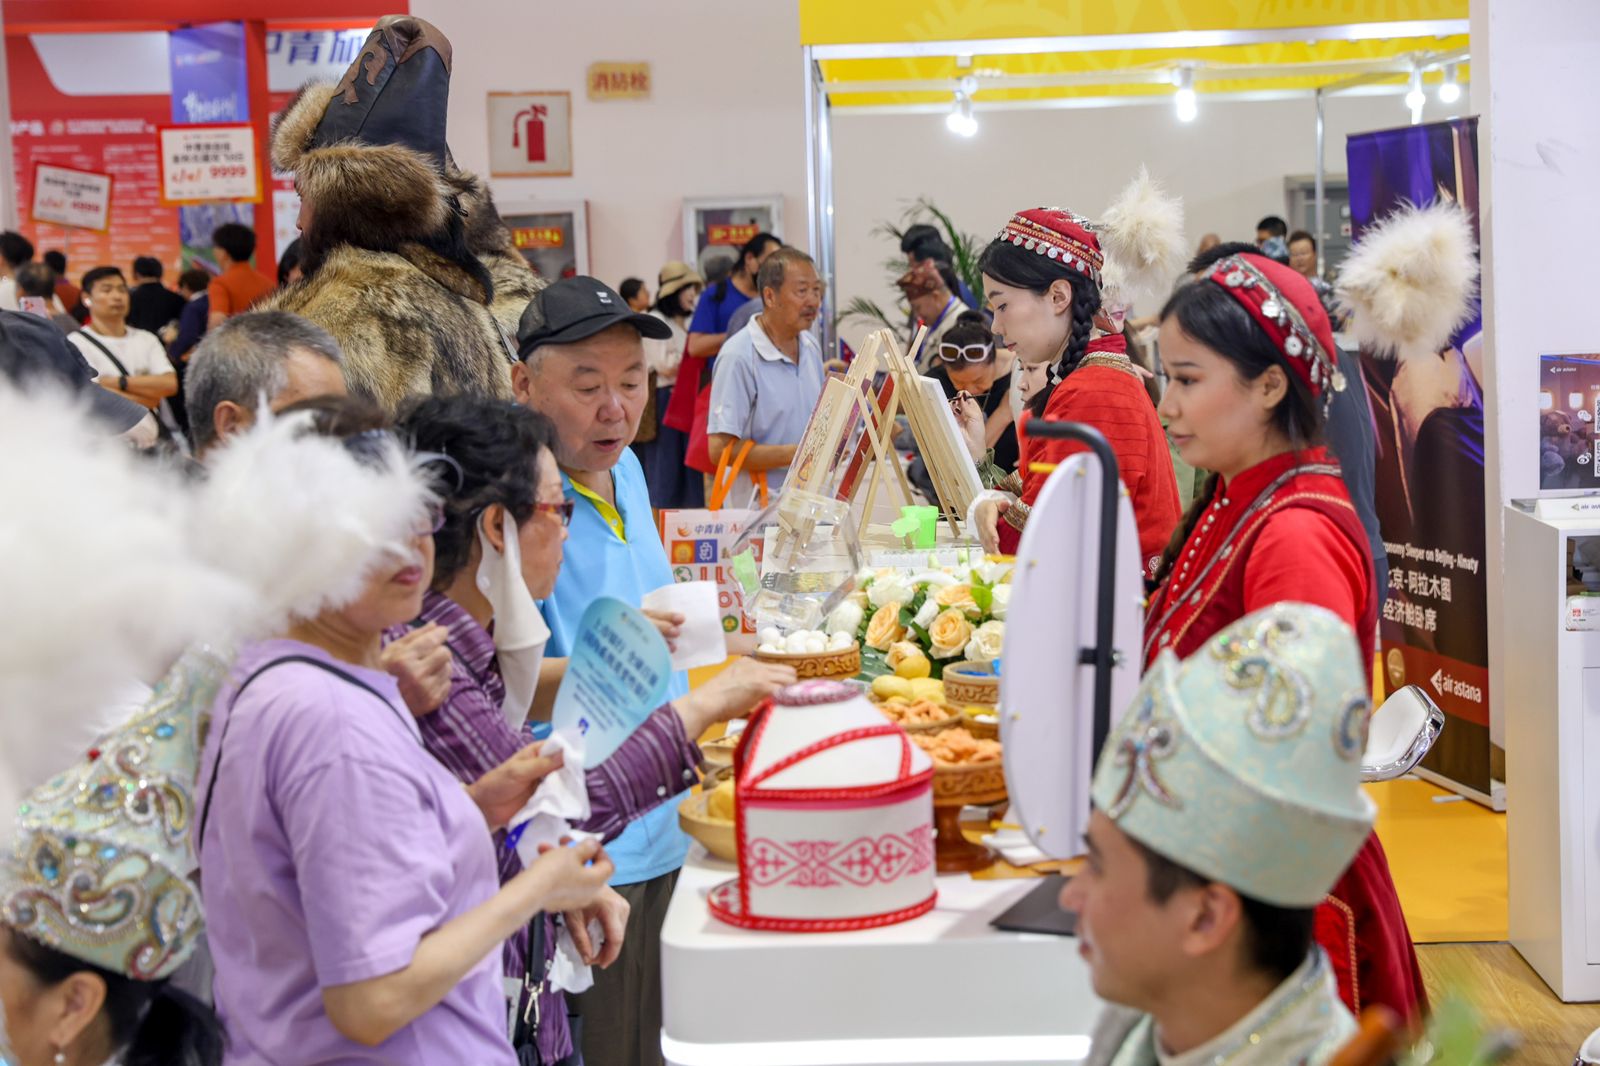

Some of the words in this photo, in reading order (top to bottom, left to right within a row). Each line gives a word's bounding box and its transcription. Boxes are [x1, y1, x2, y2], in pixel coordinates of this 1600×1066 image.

[1425, 550, 1435, 562] on
[1435, 548, 1454, 569] Beijing
[1457, 553, 1479, 574] Almaty
[1442, 674, 1454, 693] air
[1453, 681, 1482, 704] astana
